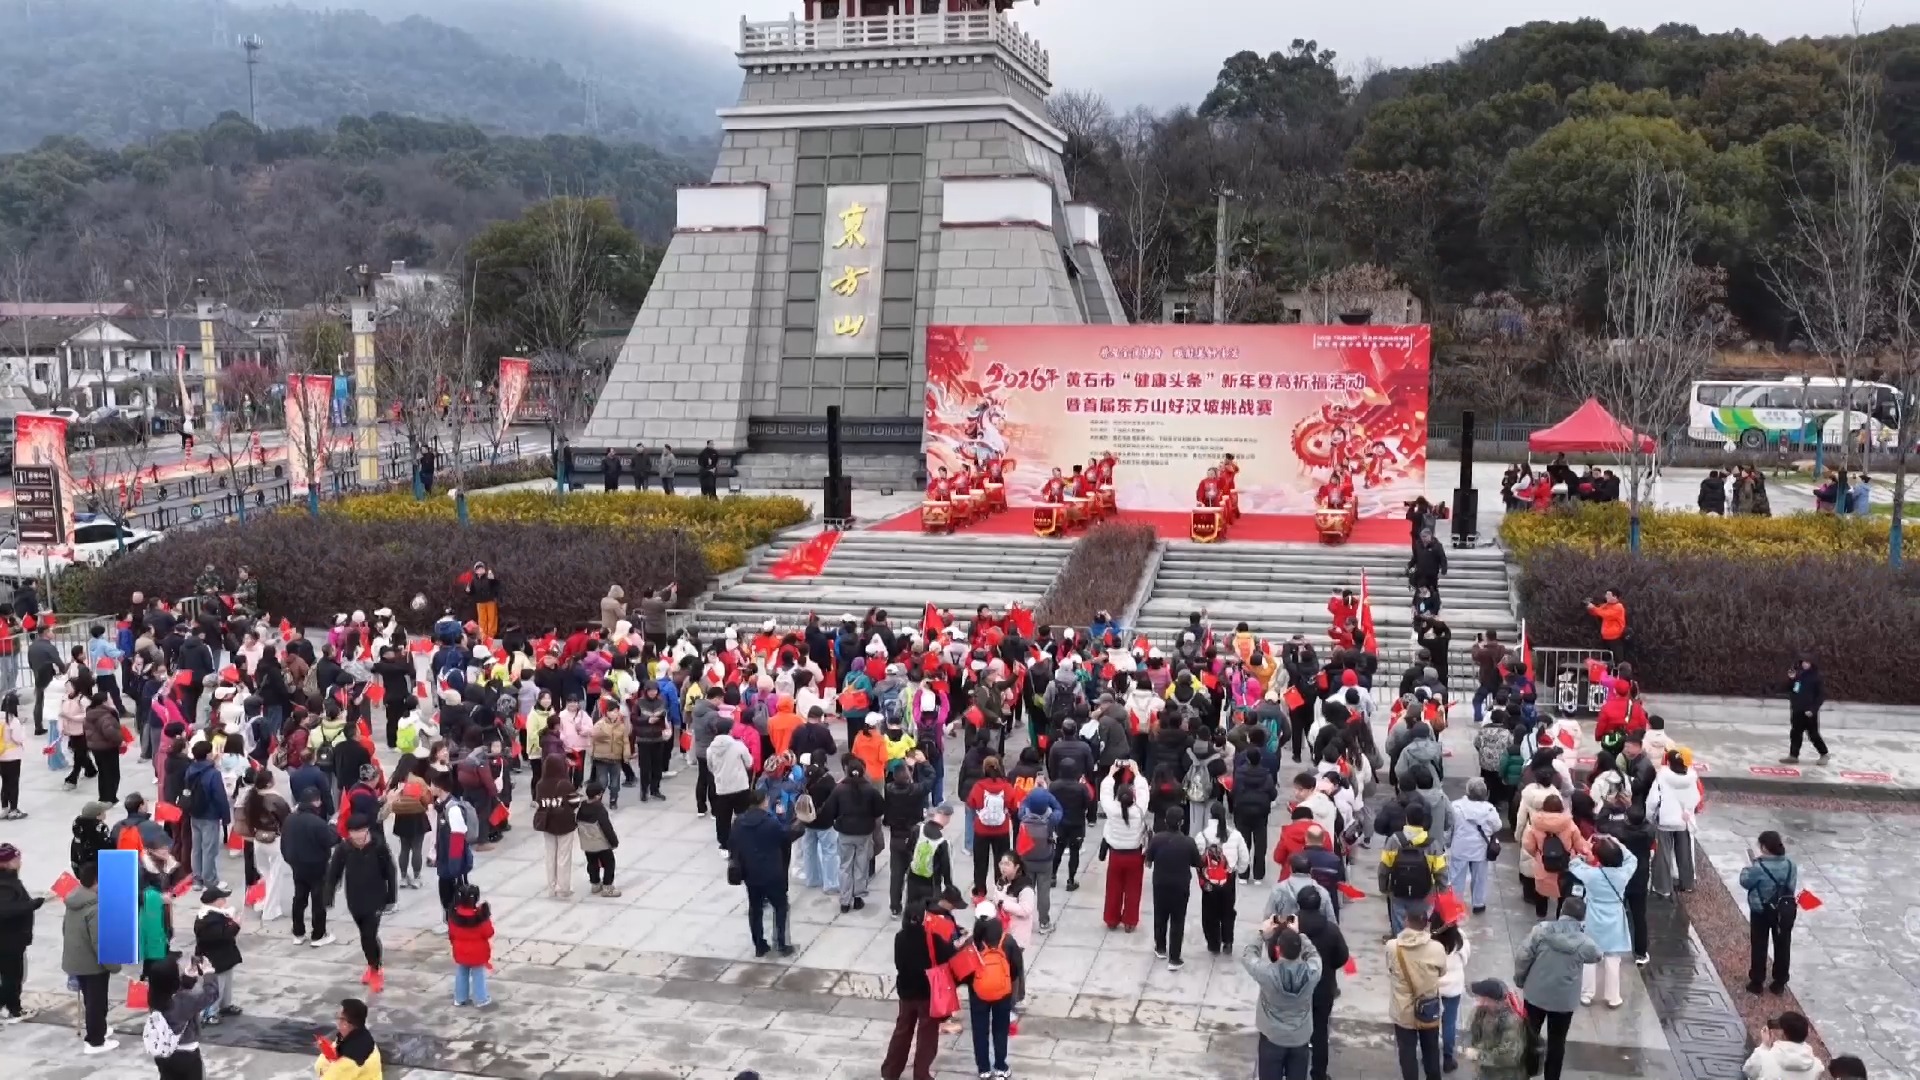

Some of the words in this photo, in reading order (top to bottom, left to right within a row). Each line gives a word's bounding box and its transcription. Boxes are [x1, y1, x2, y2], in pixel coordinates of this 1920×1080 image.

[1066, 398, 1272, 416] 暨首届东方山好汉坡挑战赛
